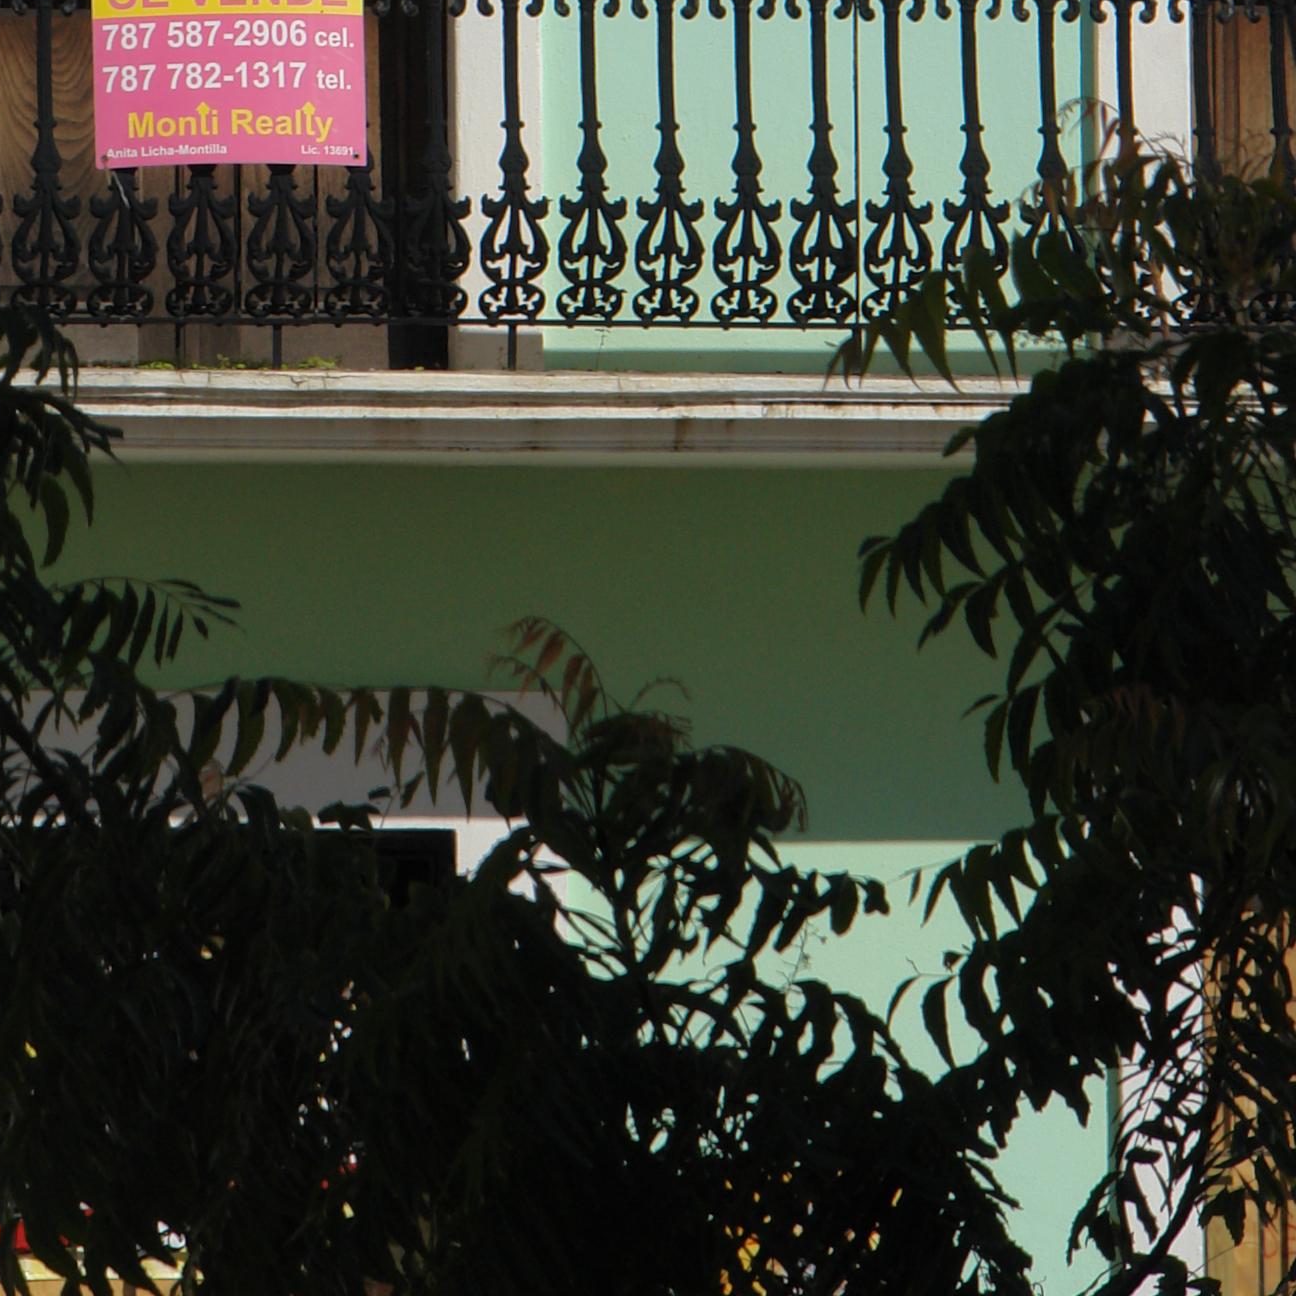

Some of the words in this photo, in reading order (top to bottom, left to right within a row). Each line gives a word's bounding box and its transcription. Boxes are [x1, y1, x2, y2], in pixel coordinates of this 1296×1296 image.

[102, 23, 156, 51] 787
[167, 19, 307, 48] 587-2906
[314, 28, 355, 48] cel.
[102, 64, 156, 93] 787
[167, 61, 307, 89] 782-1317
[316, 69, 352, 90] tel.
[127, 102, 219, 138] Monti
[231, 102, 334, 143] Realty
[106, 147, 138, 159] Anita
[141, 144, 228, 157] Licha-Montilla
[301, 144, 320, 155] Lic.
